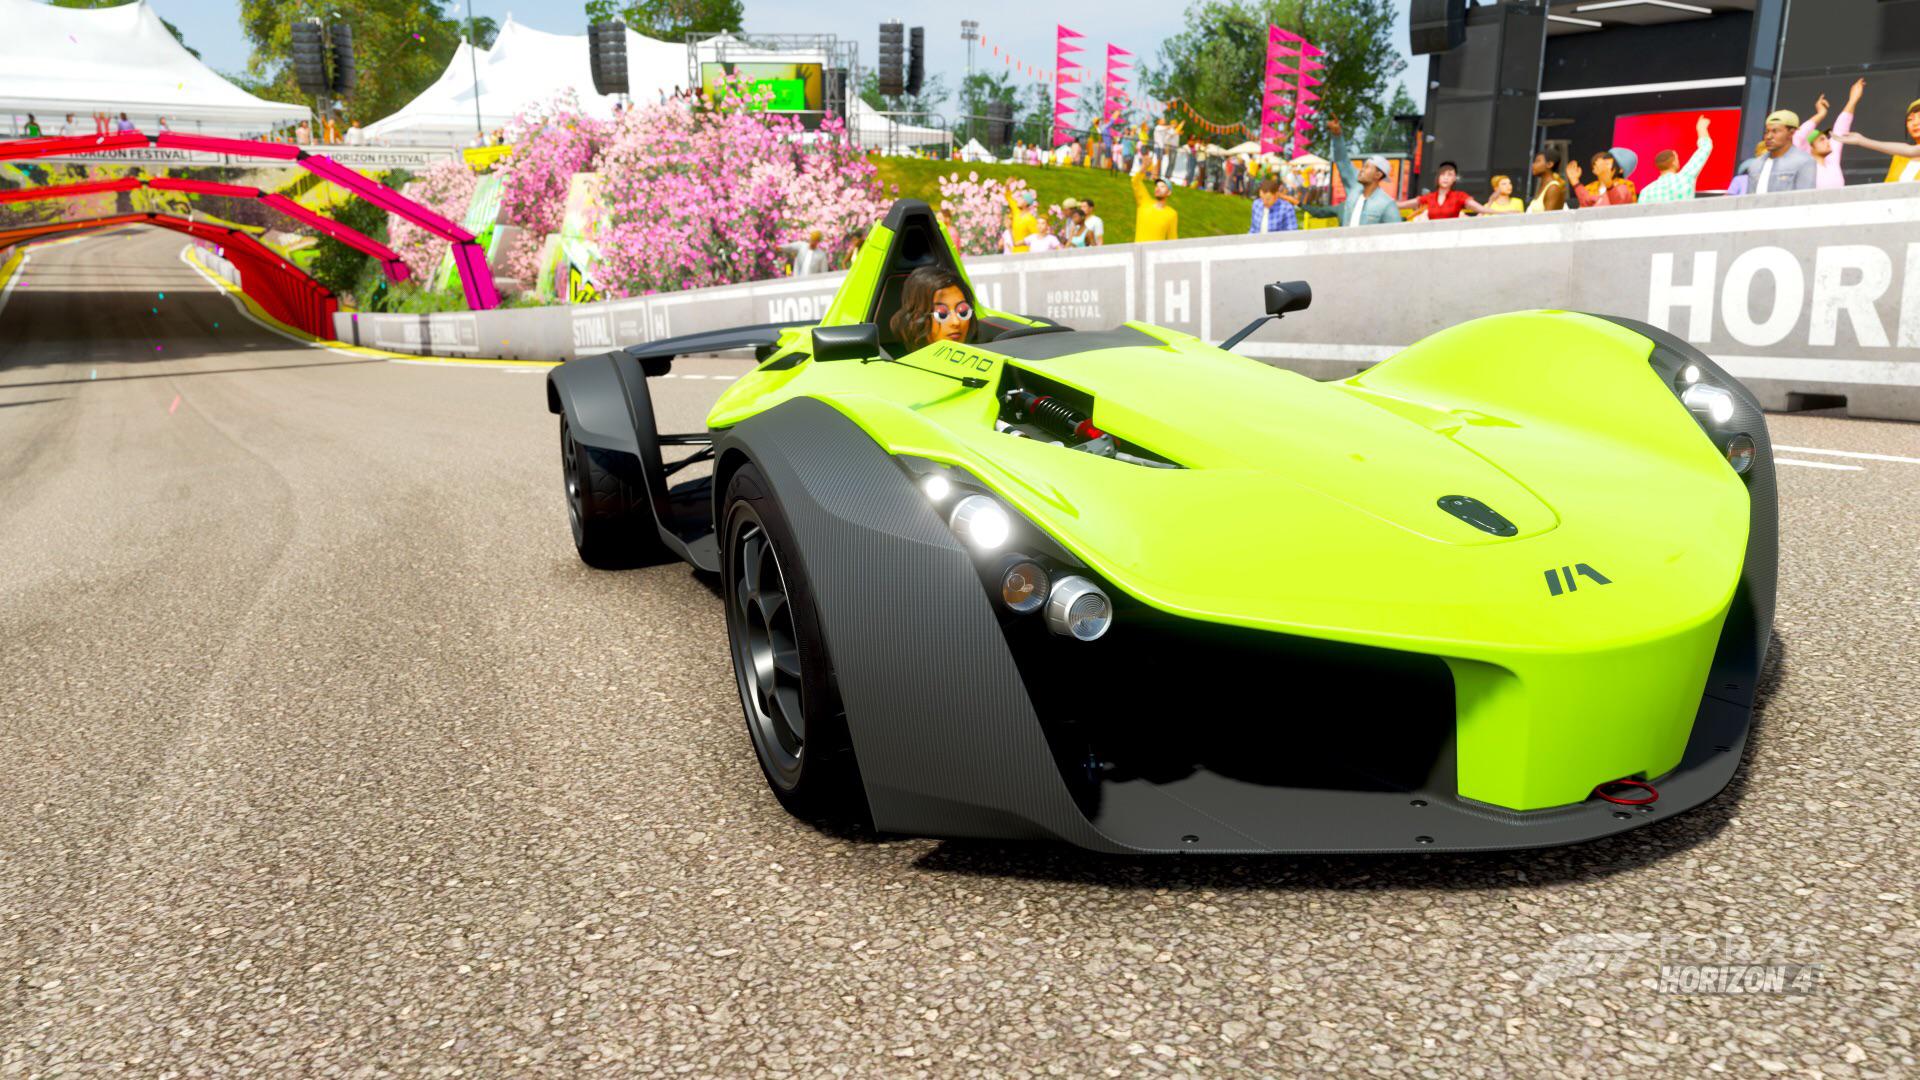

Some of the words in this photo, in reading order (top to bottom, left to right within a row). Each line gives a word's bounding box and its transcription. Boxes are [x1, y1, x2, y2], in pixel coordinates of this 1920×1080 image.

[129, 149, 187, 160] FESTIVAL
[378, 154, 425, 164] FESTIVAL
[1046, 289, 1099, 304] HORIZON
[1164, 279, 1190, 323] H
[1047, 306, 1101, 318] FESTIVAL
